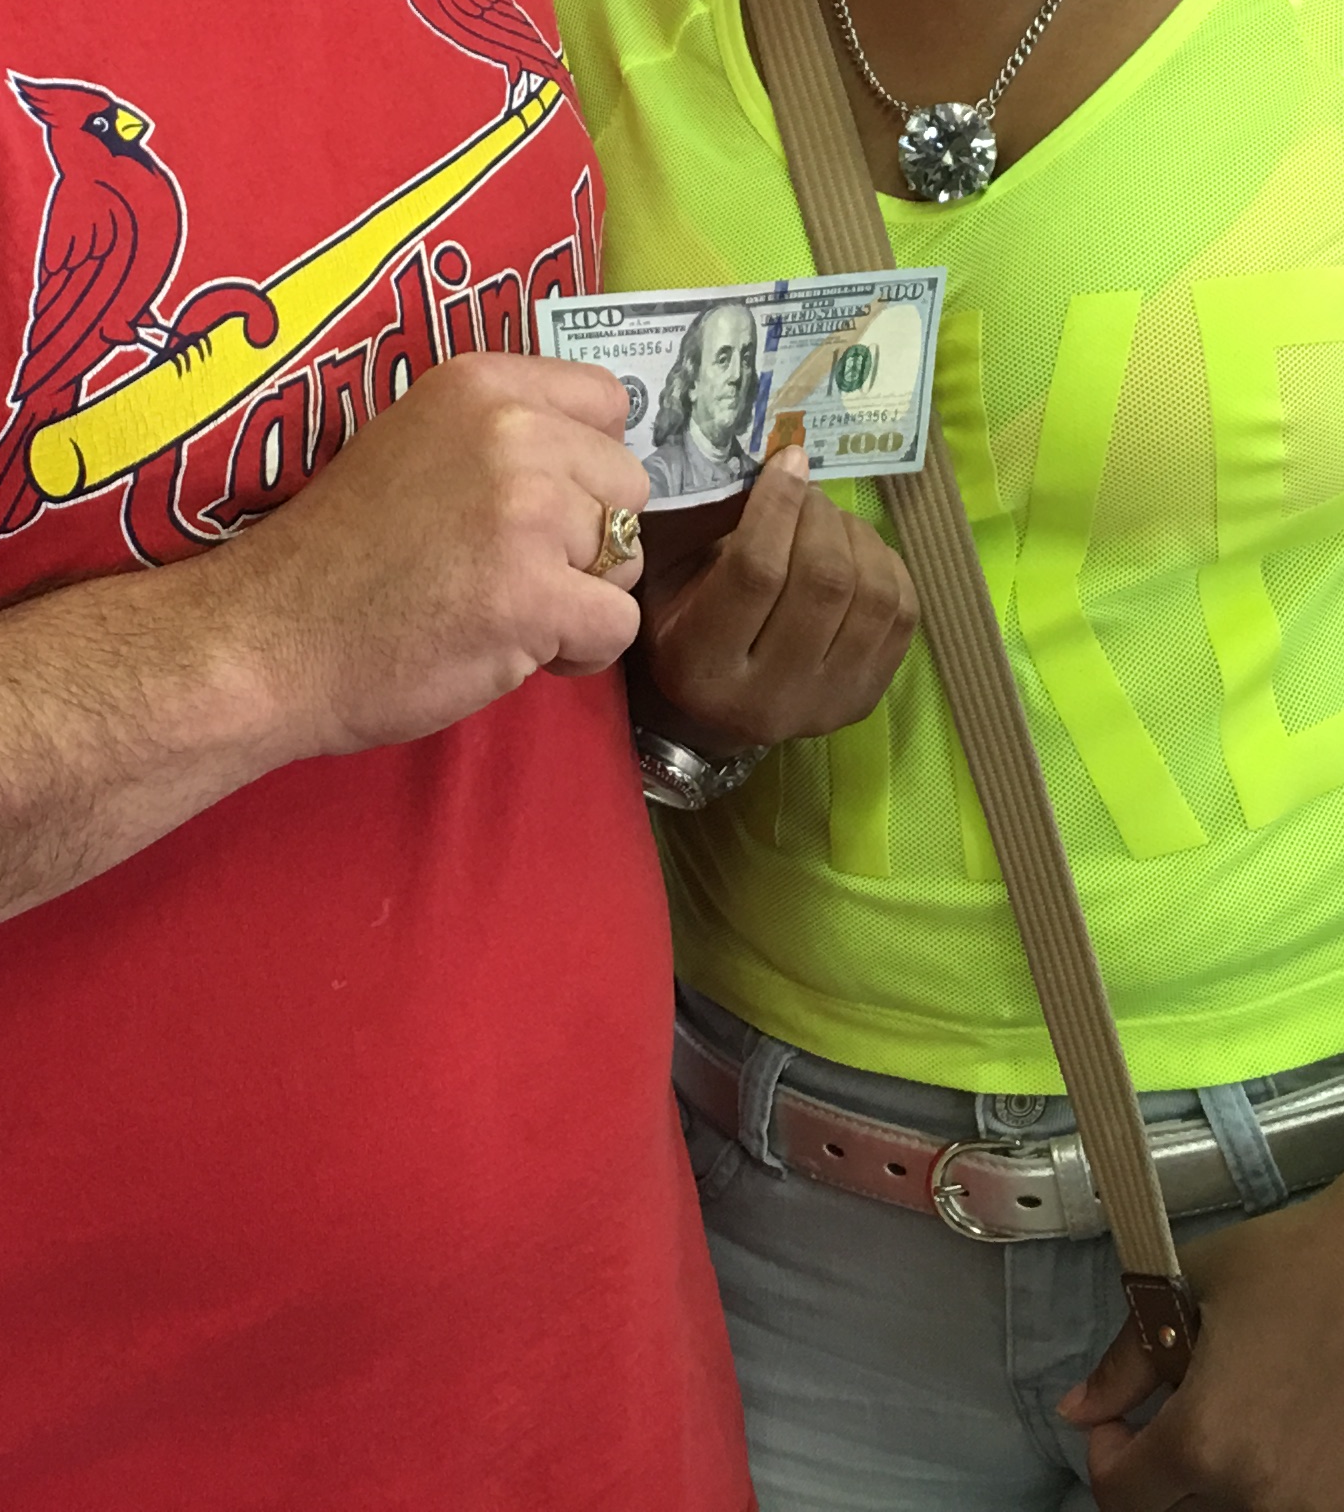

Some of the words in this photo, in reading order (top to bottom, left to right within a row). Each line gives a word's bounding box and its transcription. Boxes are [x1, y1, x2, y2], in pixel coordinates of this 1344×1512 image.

[877, 282, 924, 303] 100
[559, 307, 624, 331] 100
[567, 329, 616, 341] FEDERAL
[617, 326, 661, 337] RESERVE
[662, 324, 687, 334] NOTE
[835, 431, 905, 456] 100
